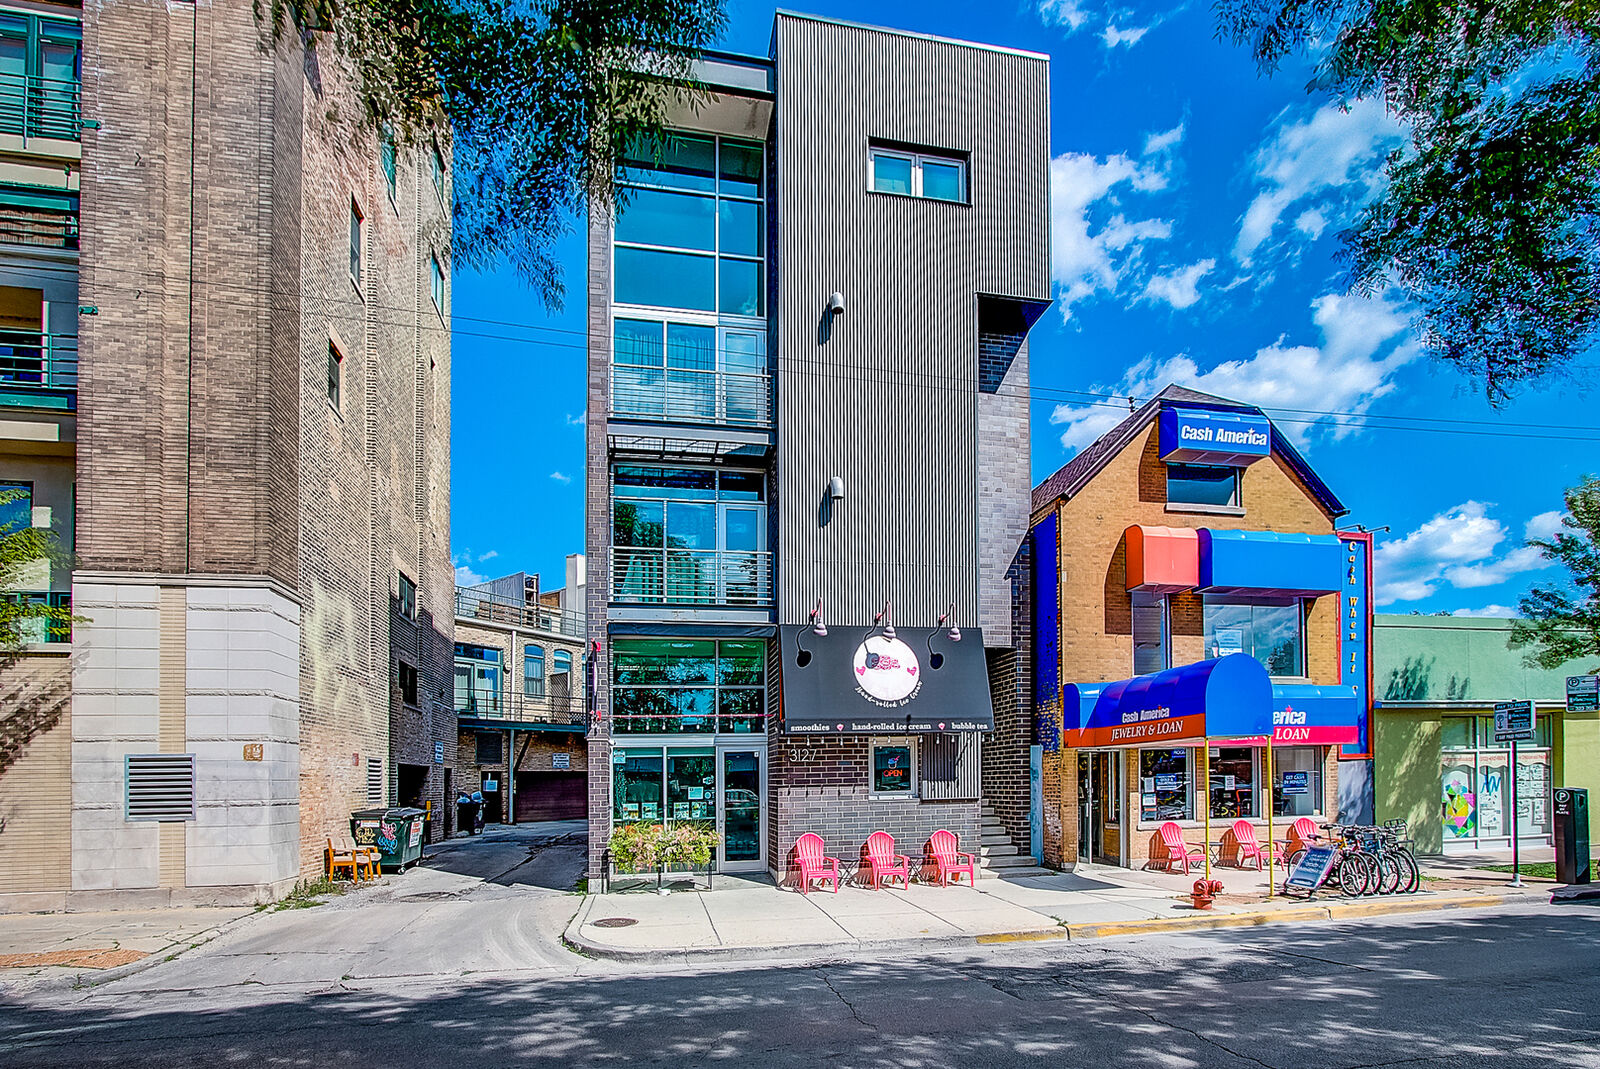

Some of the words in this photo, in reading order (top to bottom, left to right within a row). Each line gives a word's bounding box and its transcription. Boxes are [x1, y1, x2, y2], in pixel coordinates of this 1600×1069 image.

[1181, 425, 1213, 441] Cash
[1215, 427, 1267, 446] America
[1348, 541, 1357, 585] Cash
[1348, 597, 1358, 641] When
[1122, 711, 1138, 723] Cash
[1140, 705, 1170, 720] America
[1272, 705, 1306, 725] erica
[790, 724, 830, 732] smoothies
[851, 723, 894, 731] hand-rolled
[951, 722, 975, 730] bubble
[1111, 724, 1147, 742] JEWELRY
[1148, 725, 1155, 735] &
[1156, 720, 1183, 735] LOAN
[1275, 728, 1310, 740] LOAN
[789, 748, 817, 762] 3127
[883, 769, 903, 777] OPEN
